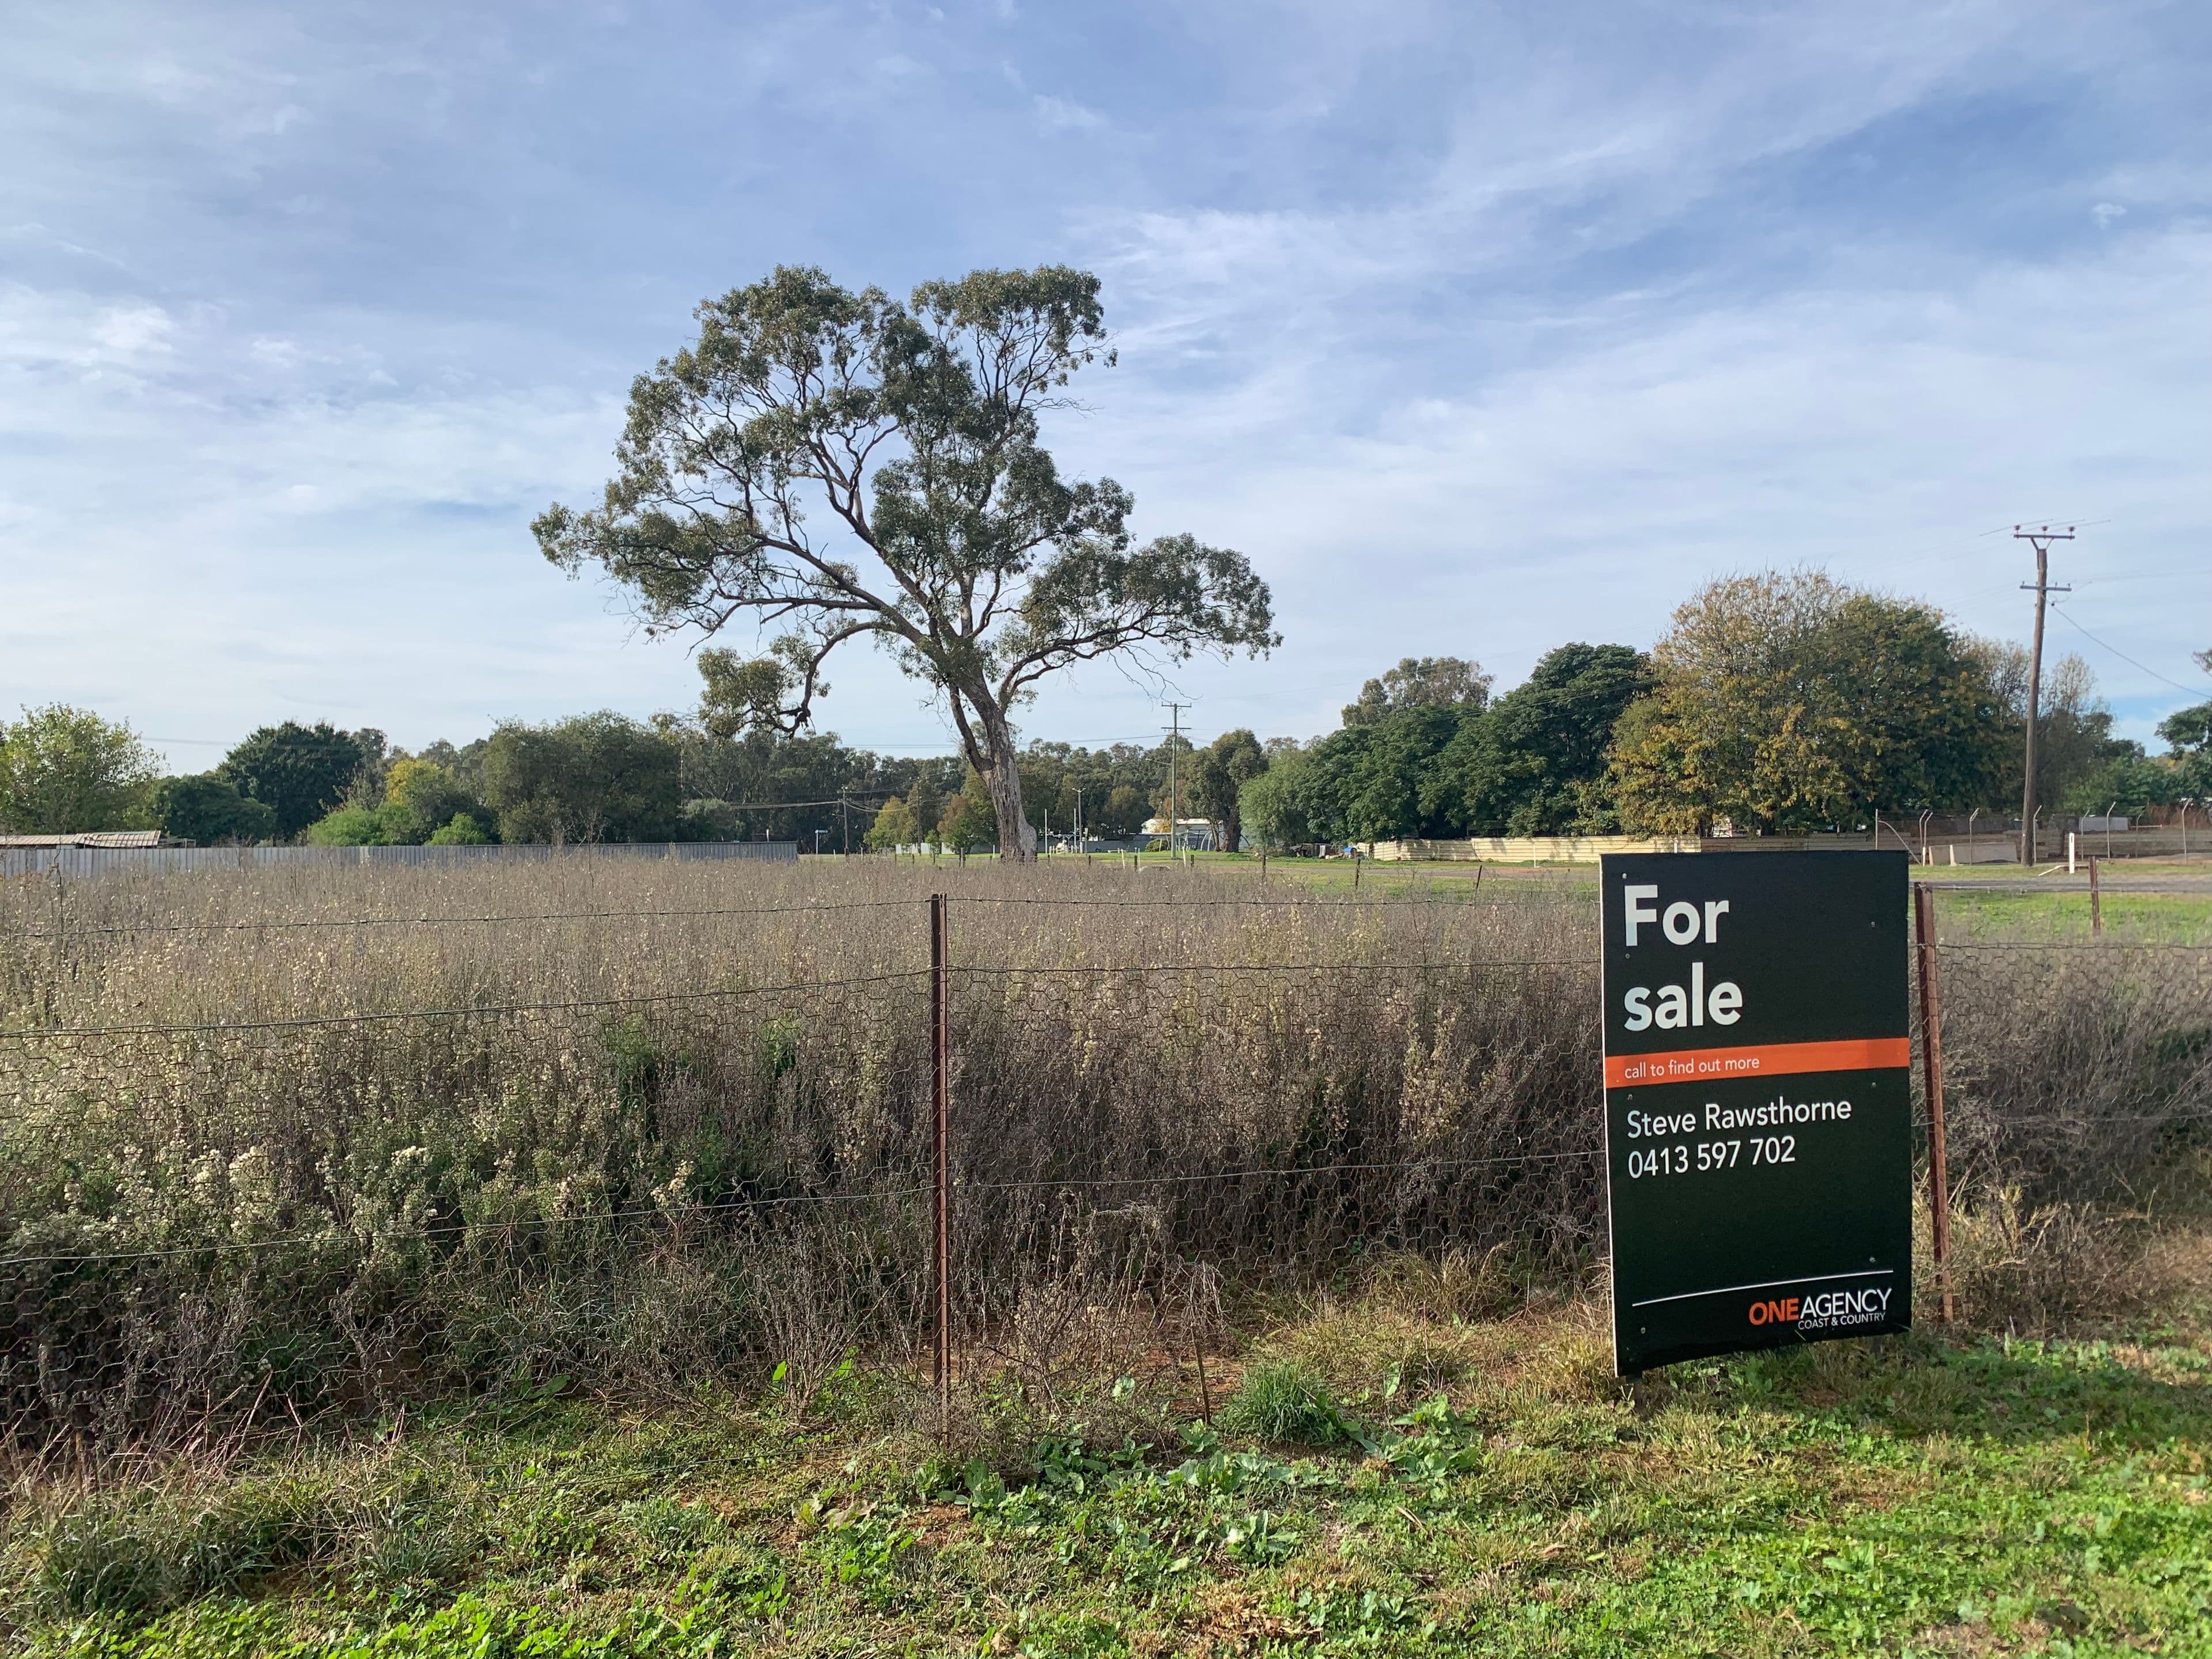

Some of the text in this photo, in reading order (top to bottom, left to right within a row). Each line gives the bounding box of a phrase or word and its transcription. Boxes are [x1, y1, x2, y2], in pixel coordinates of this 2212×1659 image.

[1624, 884, 1729, 946] For
[1624, 961, 1743, 1032] sale
[1624, 1058, 1760, 1079] call to find out more
[1627, 1096, 1851, 1138] Steve Rawsthorne
[1628, 1135, 1796, 1179] 0413 597 702
[1798, 1312, 1886, 1330] COAST & COUNTRY
